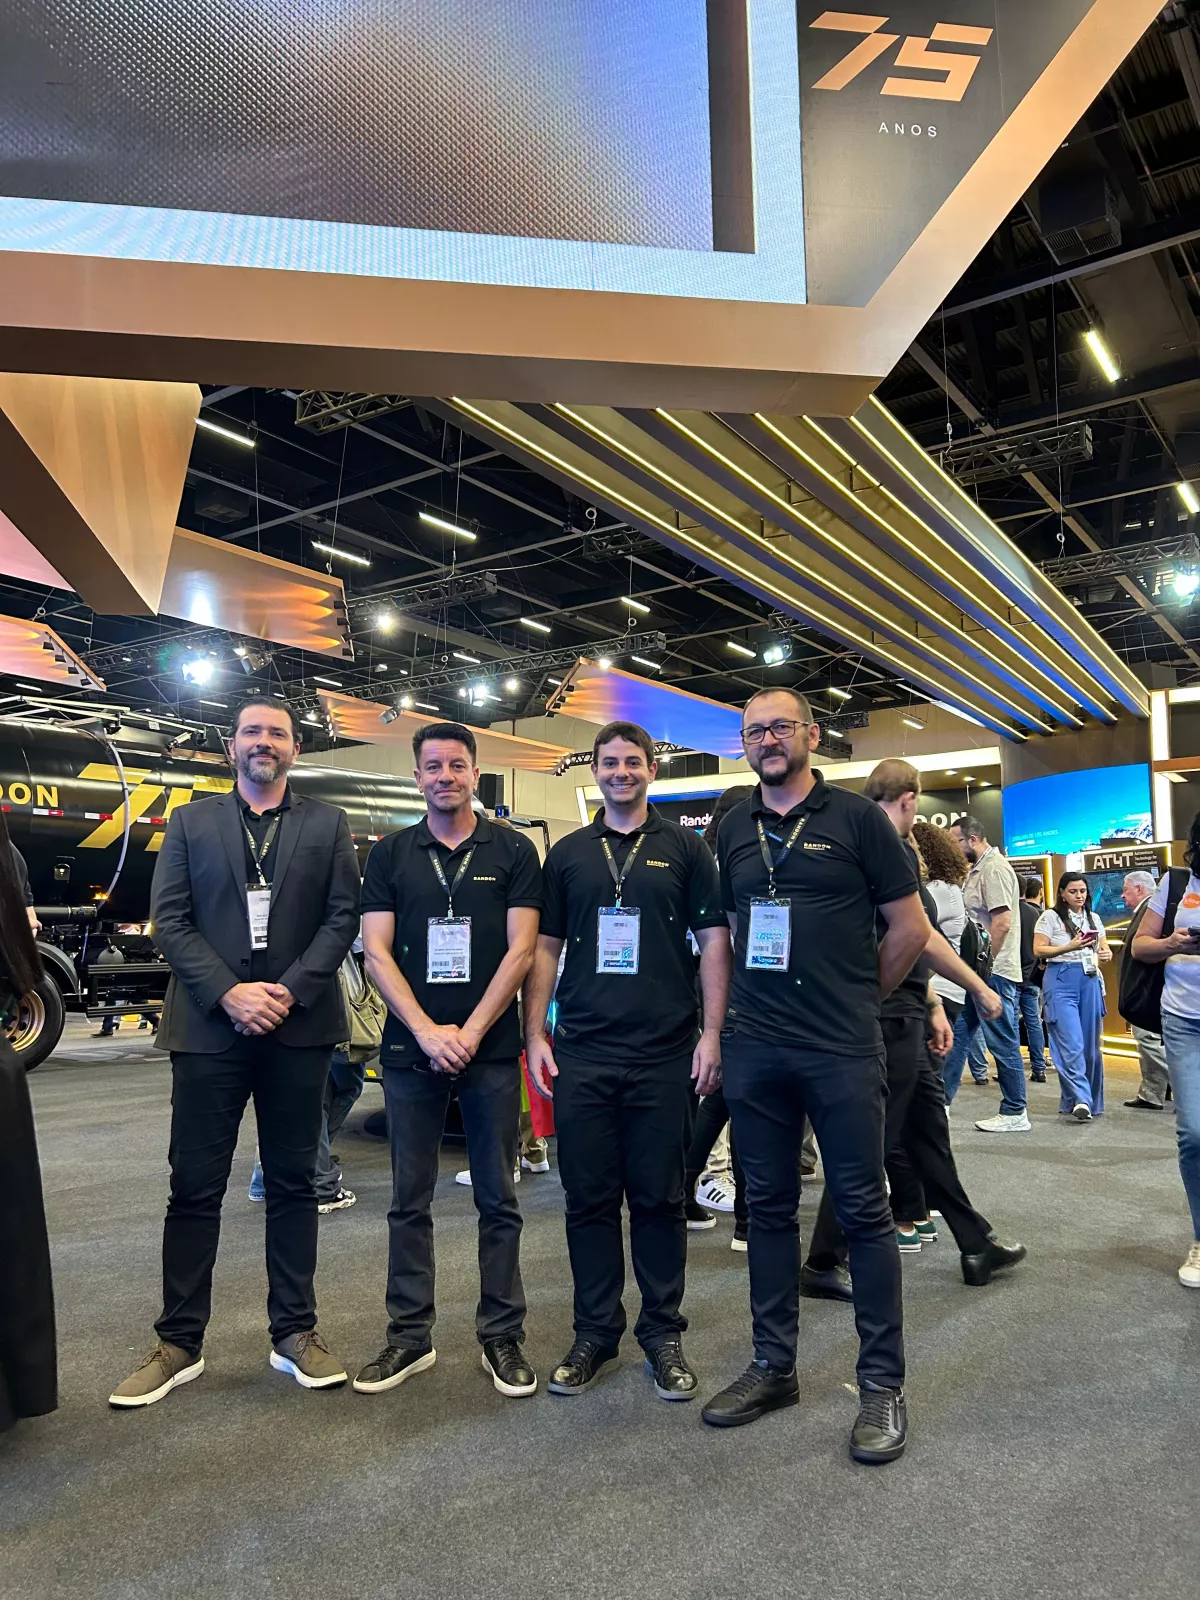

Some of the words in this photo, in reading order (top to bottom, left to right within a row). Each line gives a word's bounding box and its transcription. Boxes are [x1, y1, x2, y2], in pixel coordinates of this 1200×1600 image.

[808, 11, 994, 102] 75
[878, 121, 938, 138] ANOS
[0, 782, 59, 808] ON
[645, 859, 670, 868] RANDON
[1093, 851, 1134, 870] AT4T
